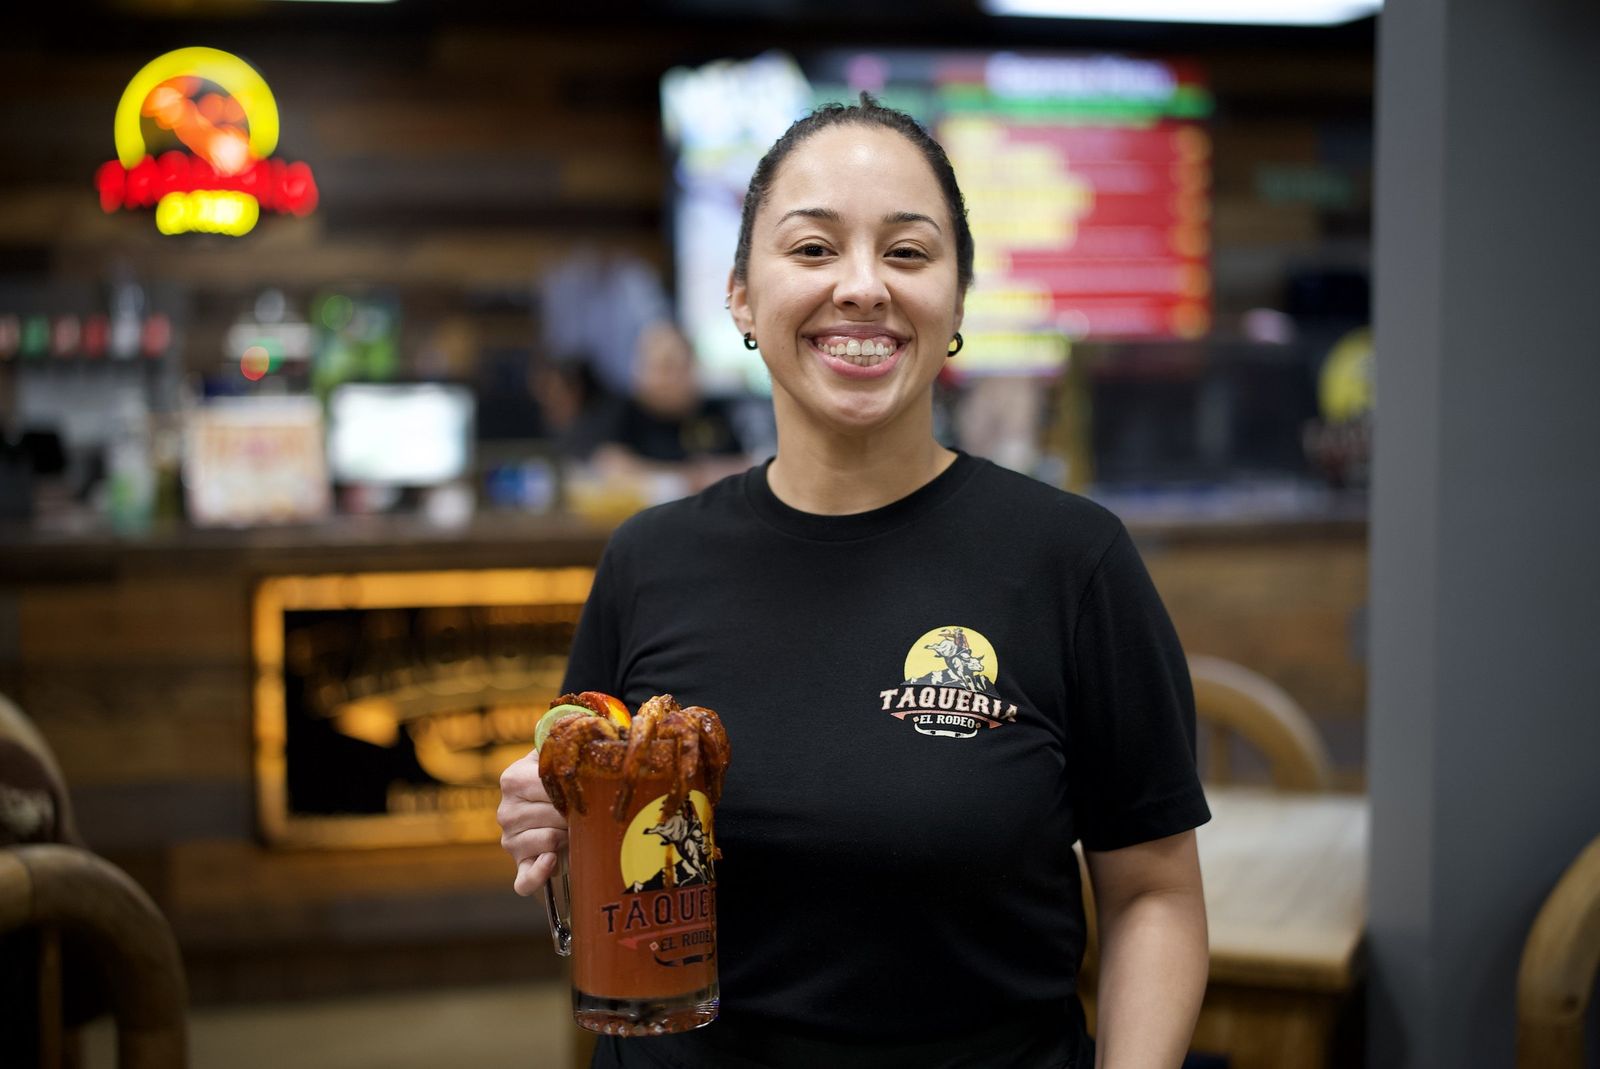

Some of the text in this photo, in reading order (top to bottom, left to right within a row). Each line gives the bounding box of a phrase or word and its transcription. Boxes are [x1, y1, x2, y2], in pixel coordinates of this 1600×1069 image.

[879, 687, 1018, 723] TAQUERIA
[919, 715, 976, 728] EL RODEO
[601, 887, 716, 934] TAQUE
[660, 929, 713, 952] EL RODE
